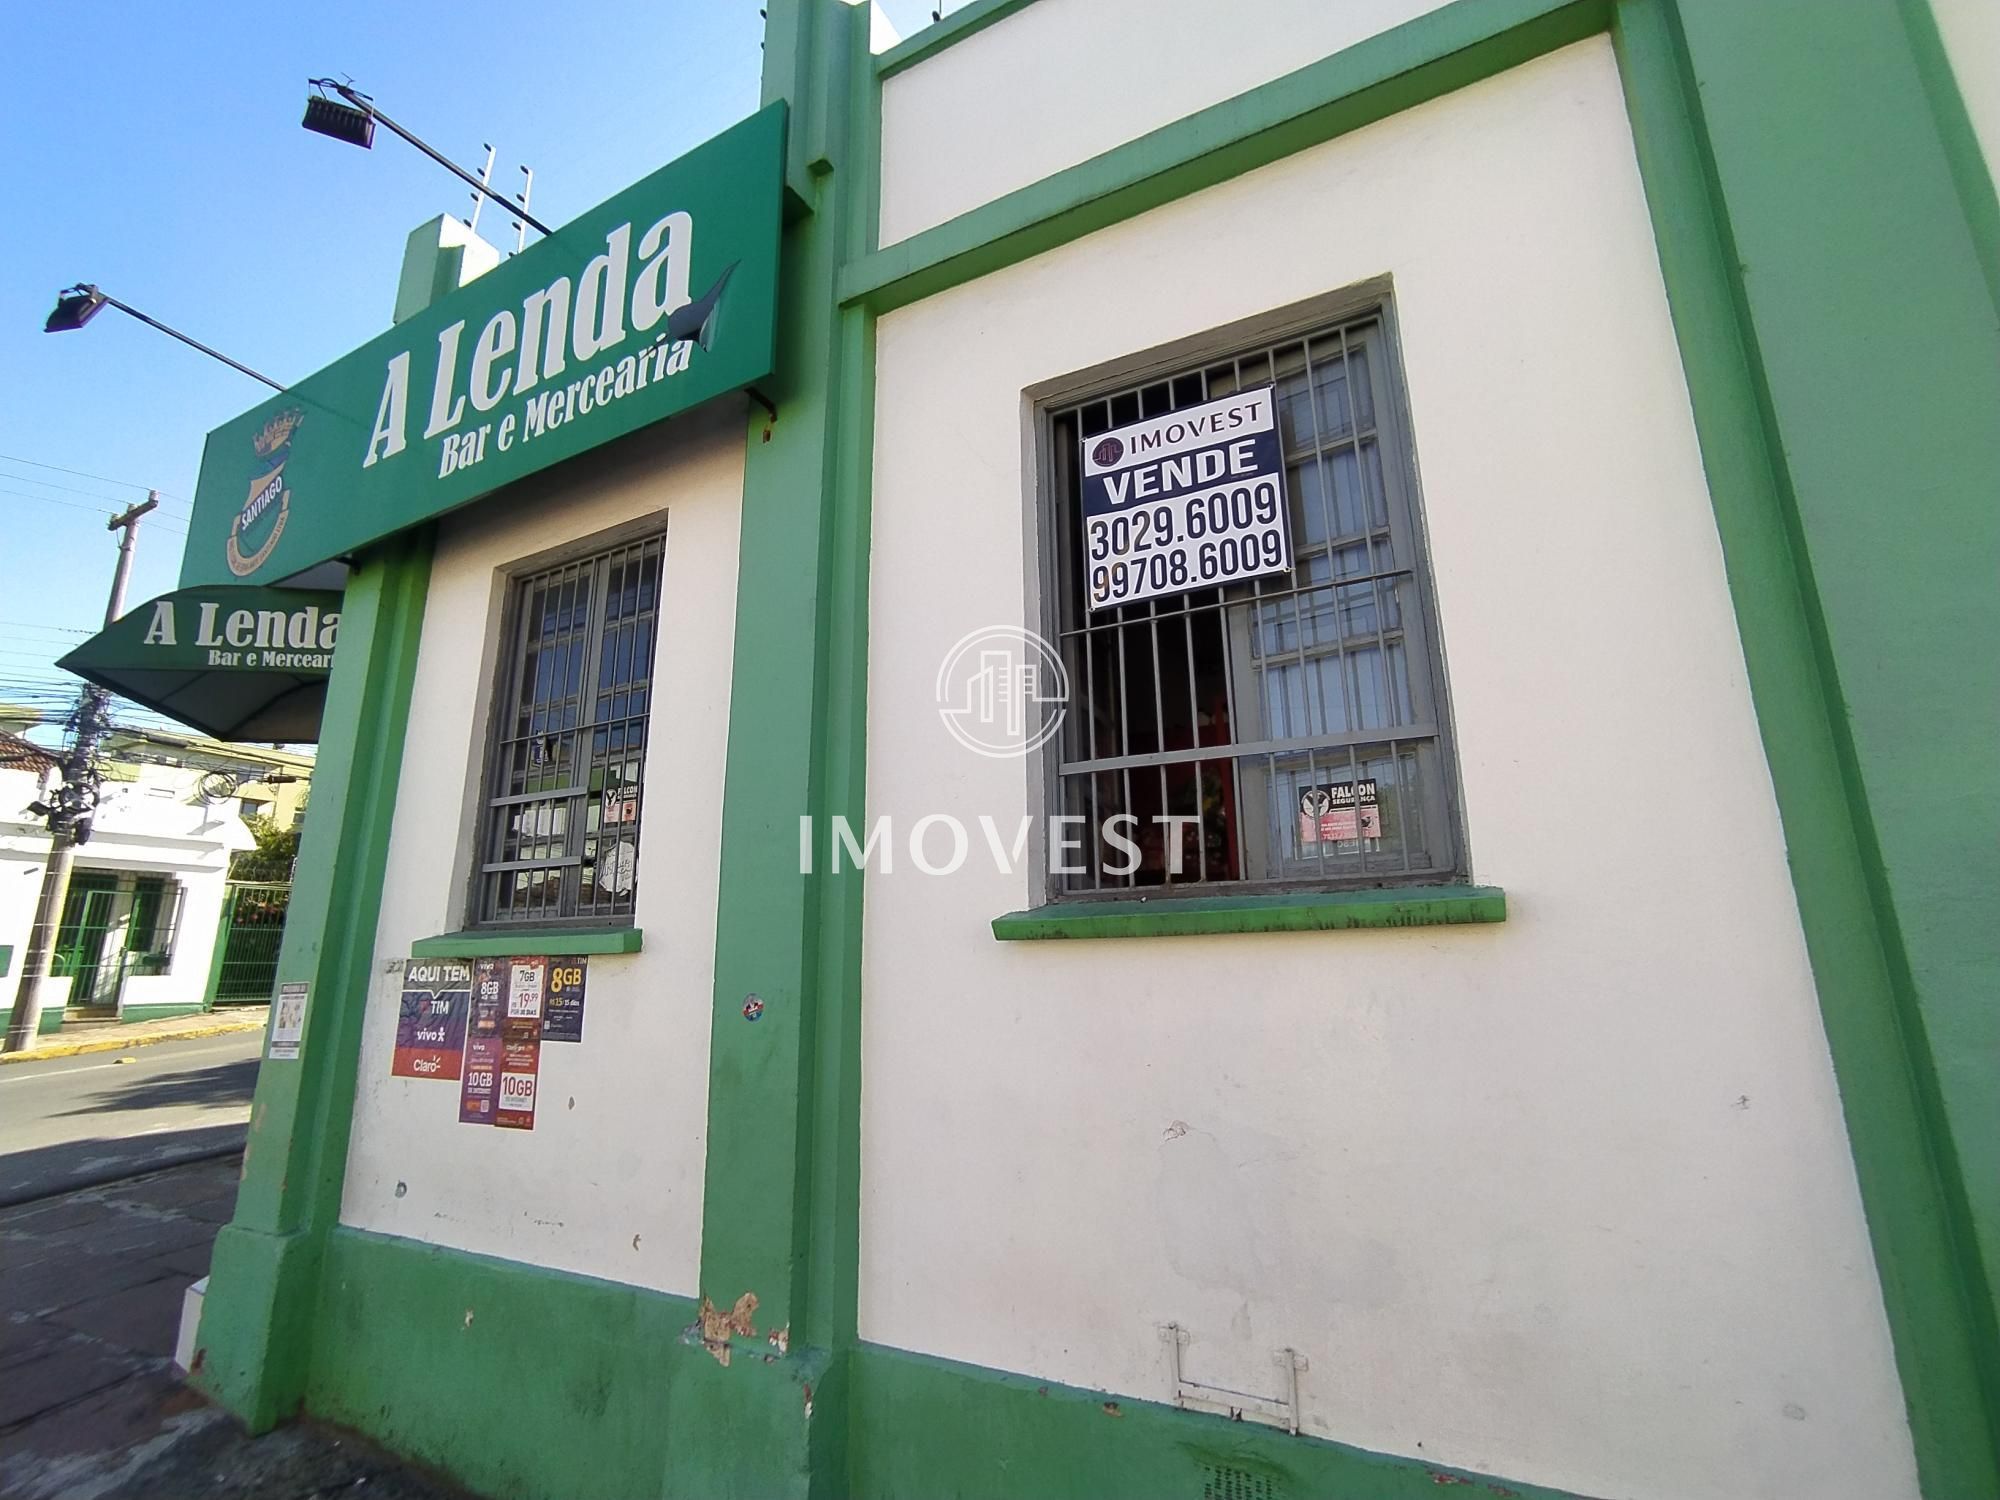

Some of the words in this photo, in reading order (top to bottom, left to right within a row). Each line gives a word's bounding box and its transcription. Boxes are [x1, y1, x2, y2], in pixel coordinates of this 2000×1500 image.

[362, 350, 410, 468] A
[423, 211, 693, 440] Lenda
[438, 424, 491, 479] Bar
[497, 413, 516, 451] e
[522, 332, 694, 443] Mercearia
[1131, 401, 1262, 454] IMOVEST
[1103, 439, 1258, 505] VENDE
[241, 475, 283, 531] SANTIAGO
[1090, 482, 1277, 560] 3029.6009
[1092, 529, 1282, 602] 99708.6009
[144, 601, 177, 645] A
[208, 649, 241, 667] Bar
[246, 652, 257, 667] e
[1333, 796, 1376, 805] SEGURNÇA
[408, 966, 440, 982] AQUI
[442, 966, 471, 982] TEM
[519, 970, 536, 982] 7GB
[551, 967, 582, 993] 8GB
[481, 981, 500, 995] 8GB
[430, 1001, 450, 1014] TIM
[417, 1030, 438, 1042] vivo
[413, 1057, 437, 1073] Claro
